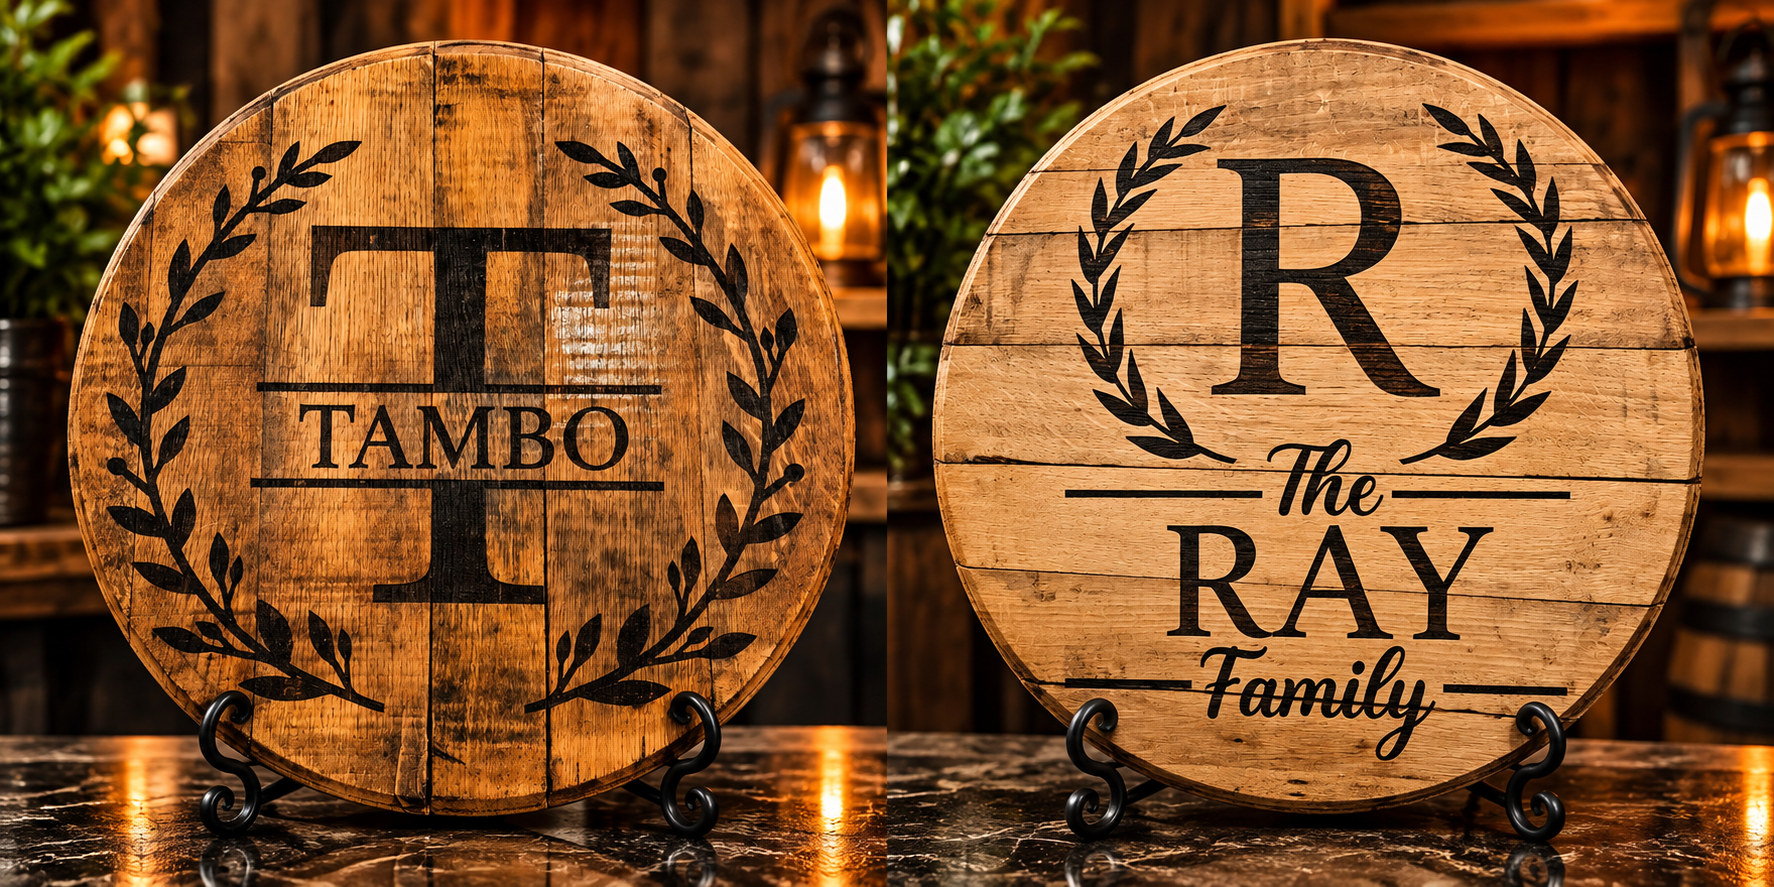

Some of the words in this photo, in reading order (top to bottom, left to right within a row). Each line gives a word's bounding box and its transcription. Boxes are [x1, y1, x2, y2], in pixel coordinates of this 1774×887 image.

[1211, 158, 1441, 397] R
[300, 404, 629, 471] TAMBO
[310, 225, 612, 604] T
[1267, 438, 1384, 516] The
[1167, 525, 1494, 640] RAY
[1200, 646, 1435, 761] Family
